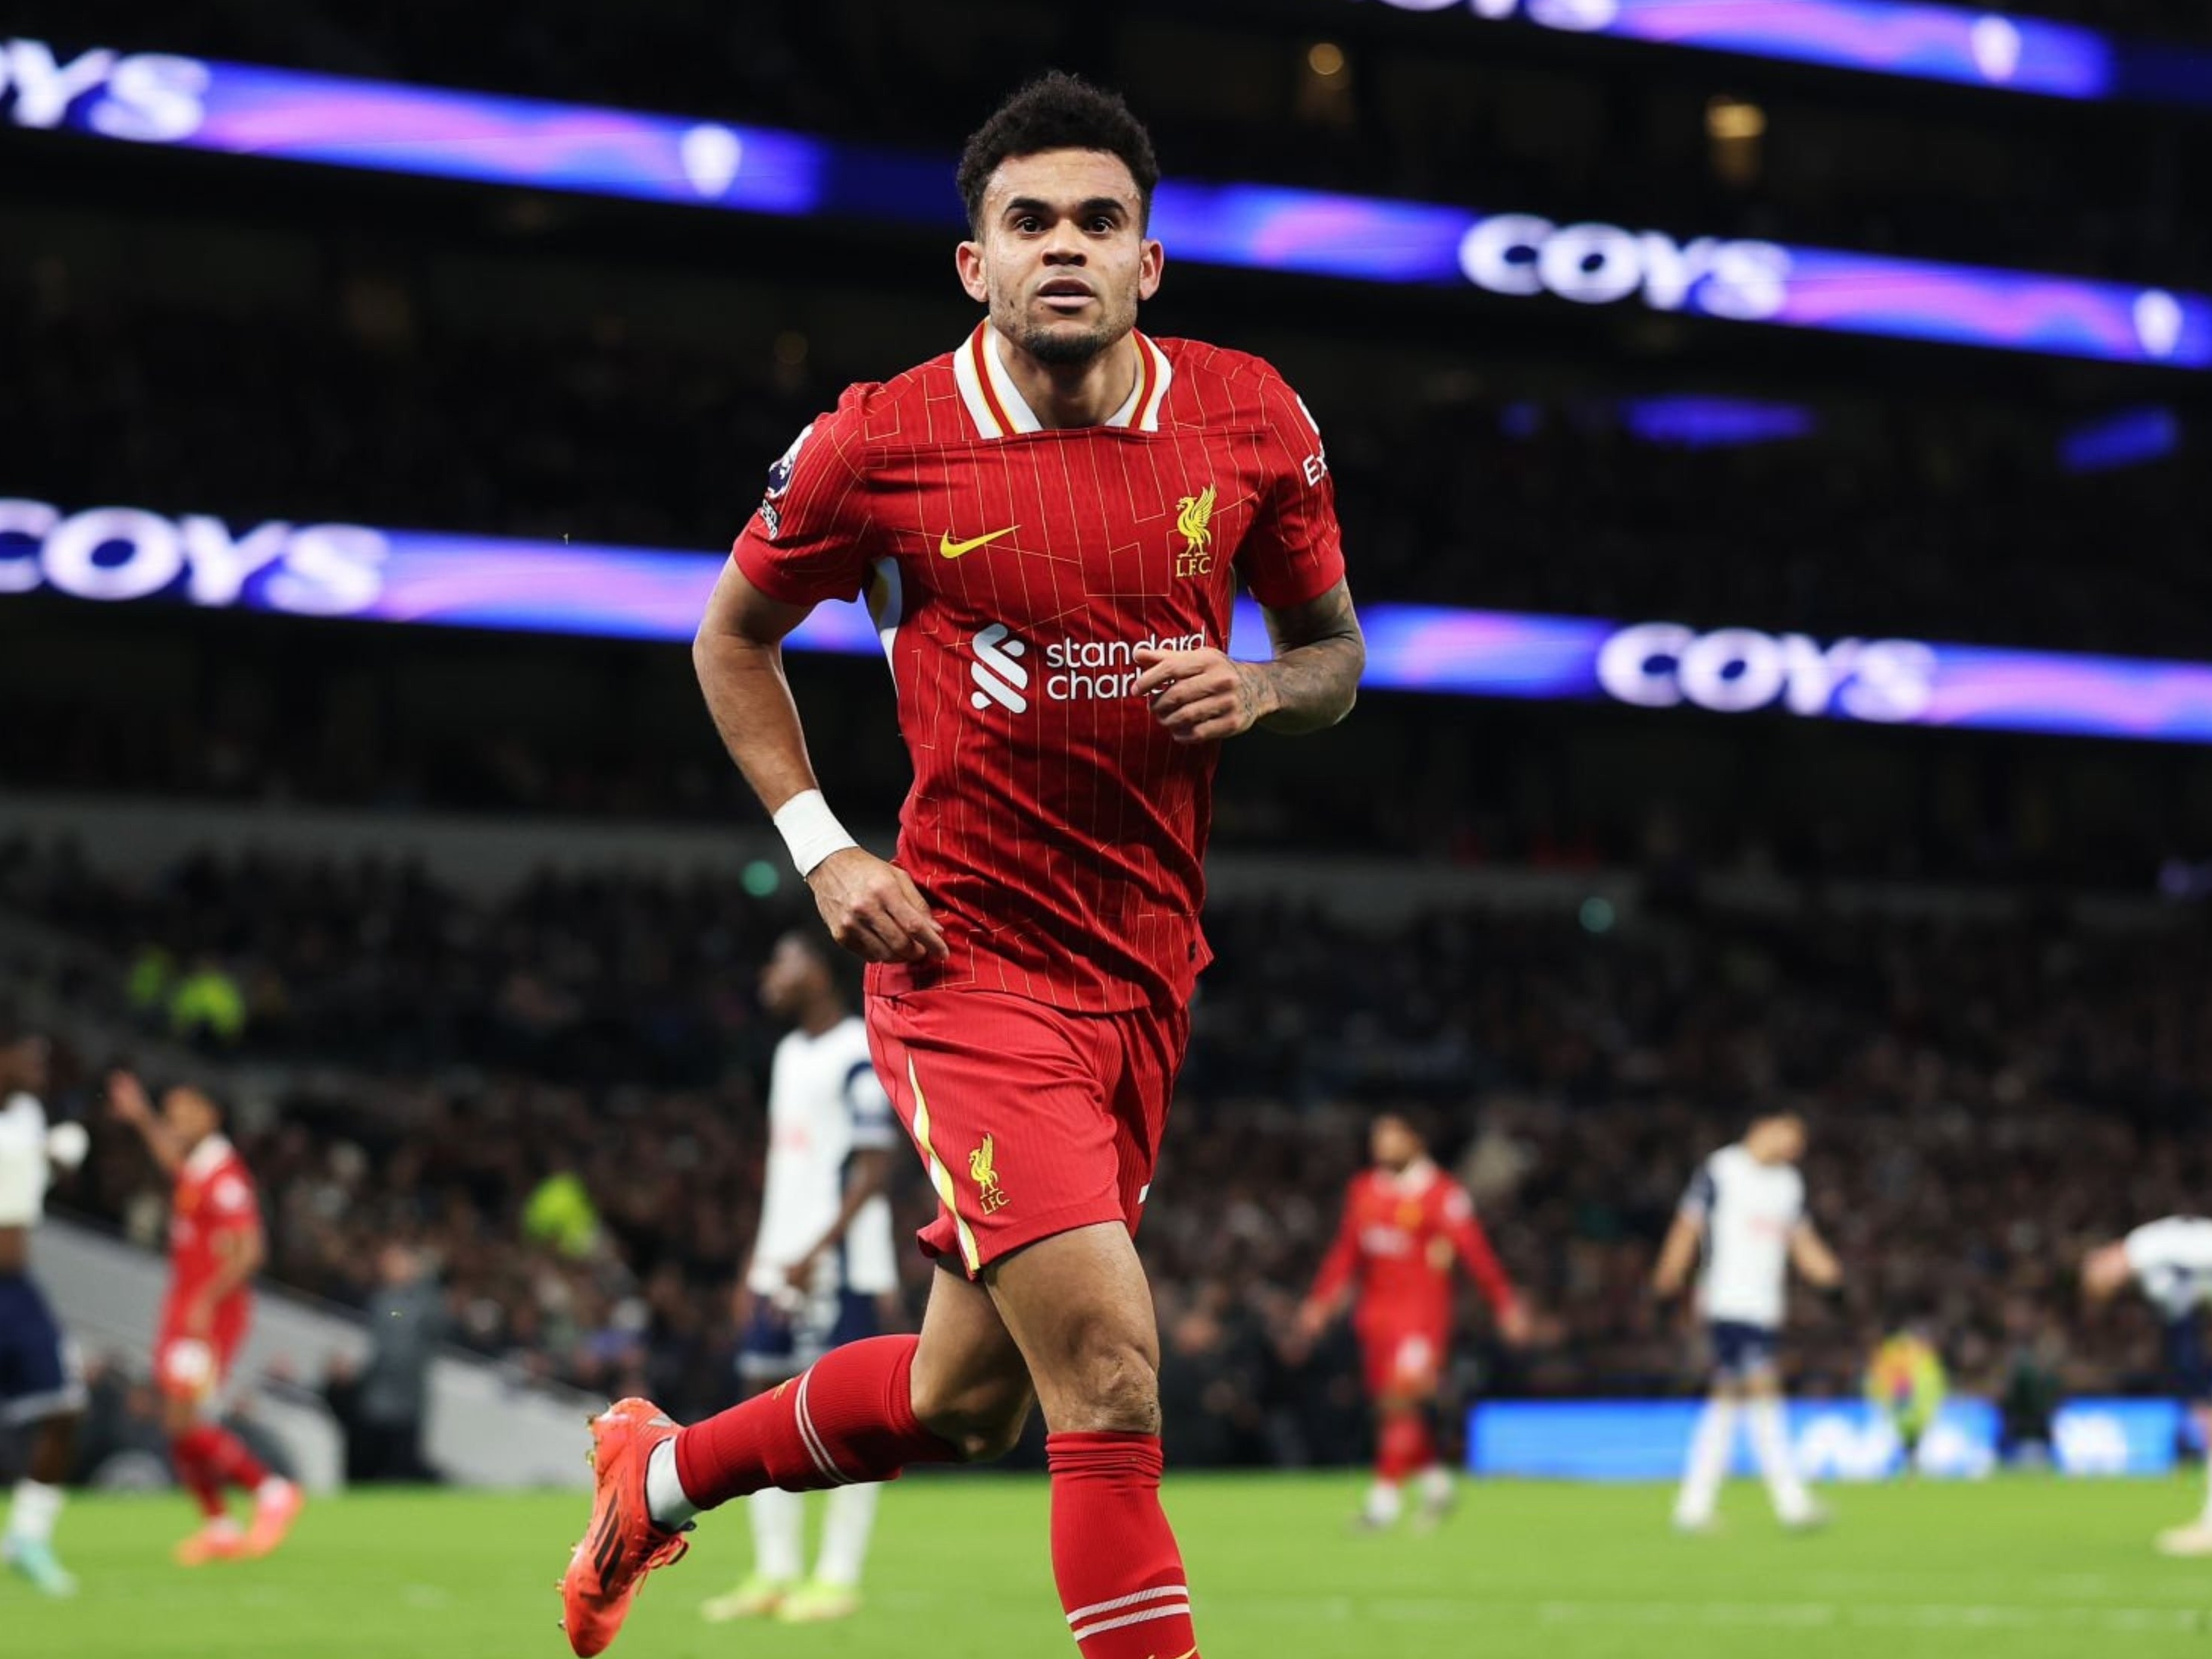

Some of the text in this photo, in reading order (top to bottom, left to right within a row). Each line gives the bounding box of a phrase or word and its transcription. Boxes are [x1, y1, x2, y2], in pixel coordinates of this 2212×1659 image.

[0, 38, 210, 143] YS
[1457, 212, 1791, 321] COYS
[1302, 439, 1328, 488] Ex
[1596, 619, 1938, 724] COYS
